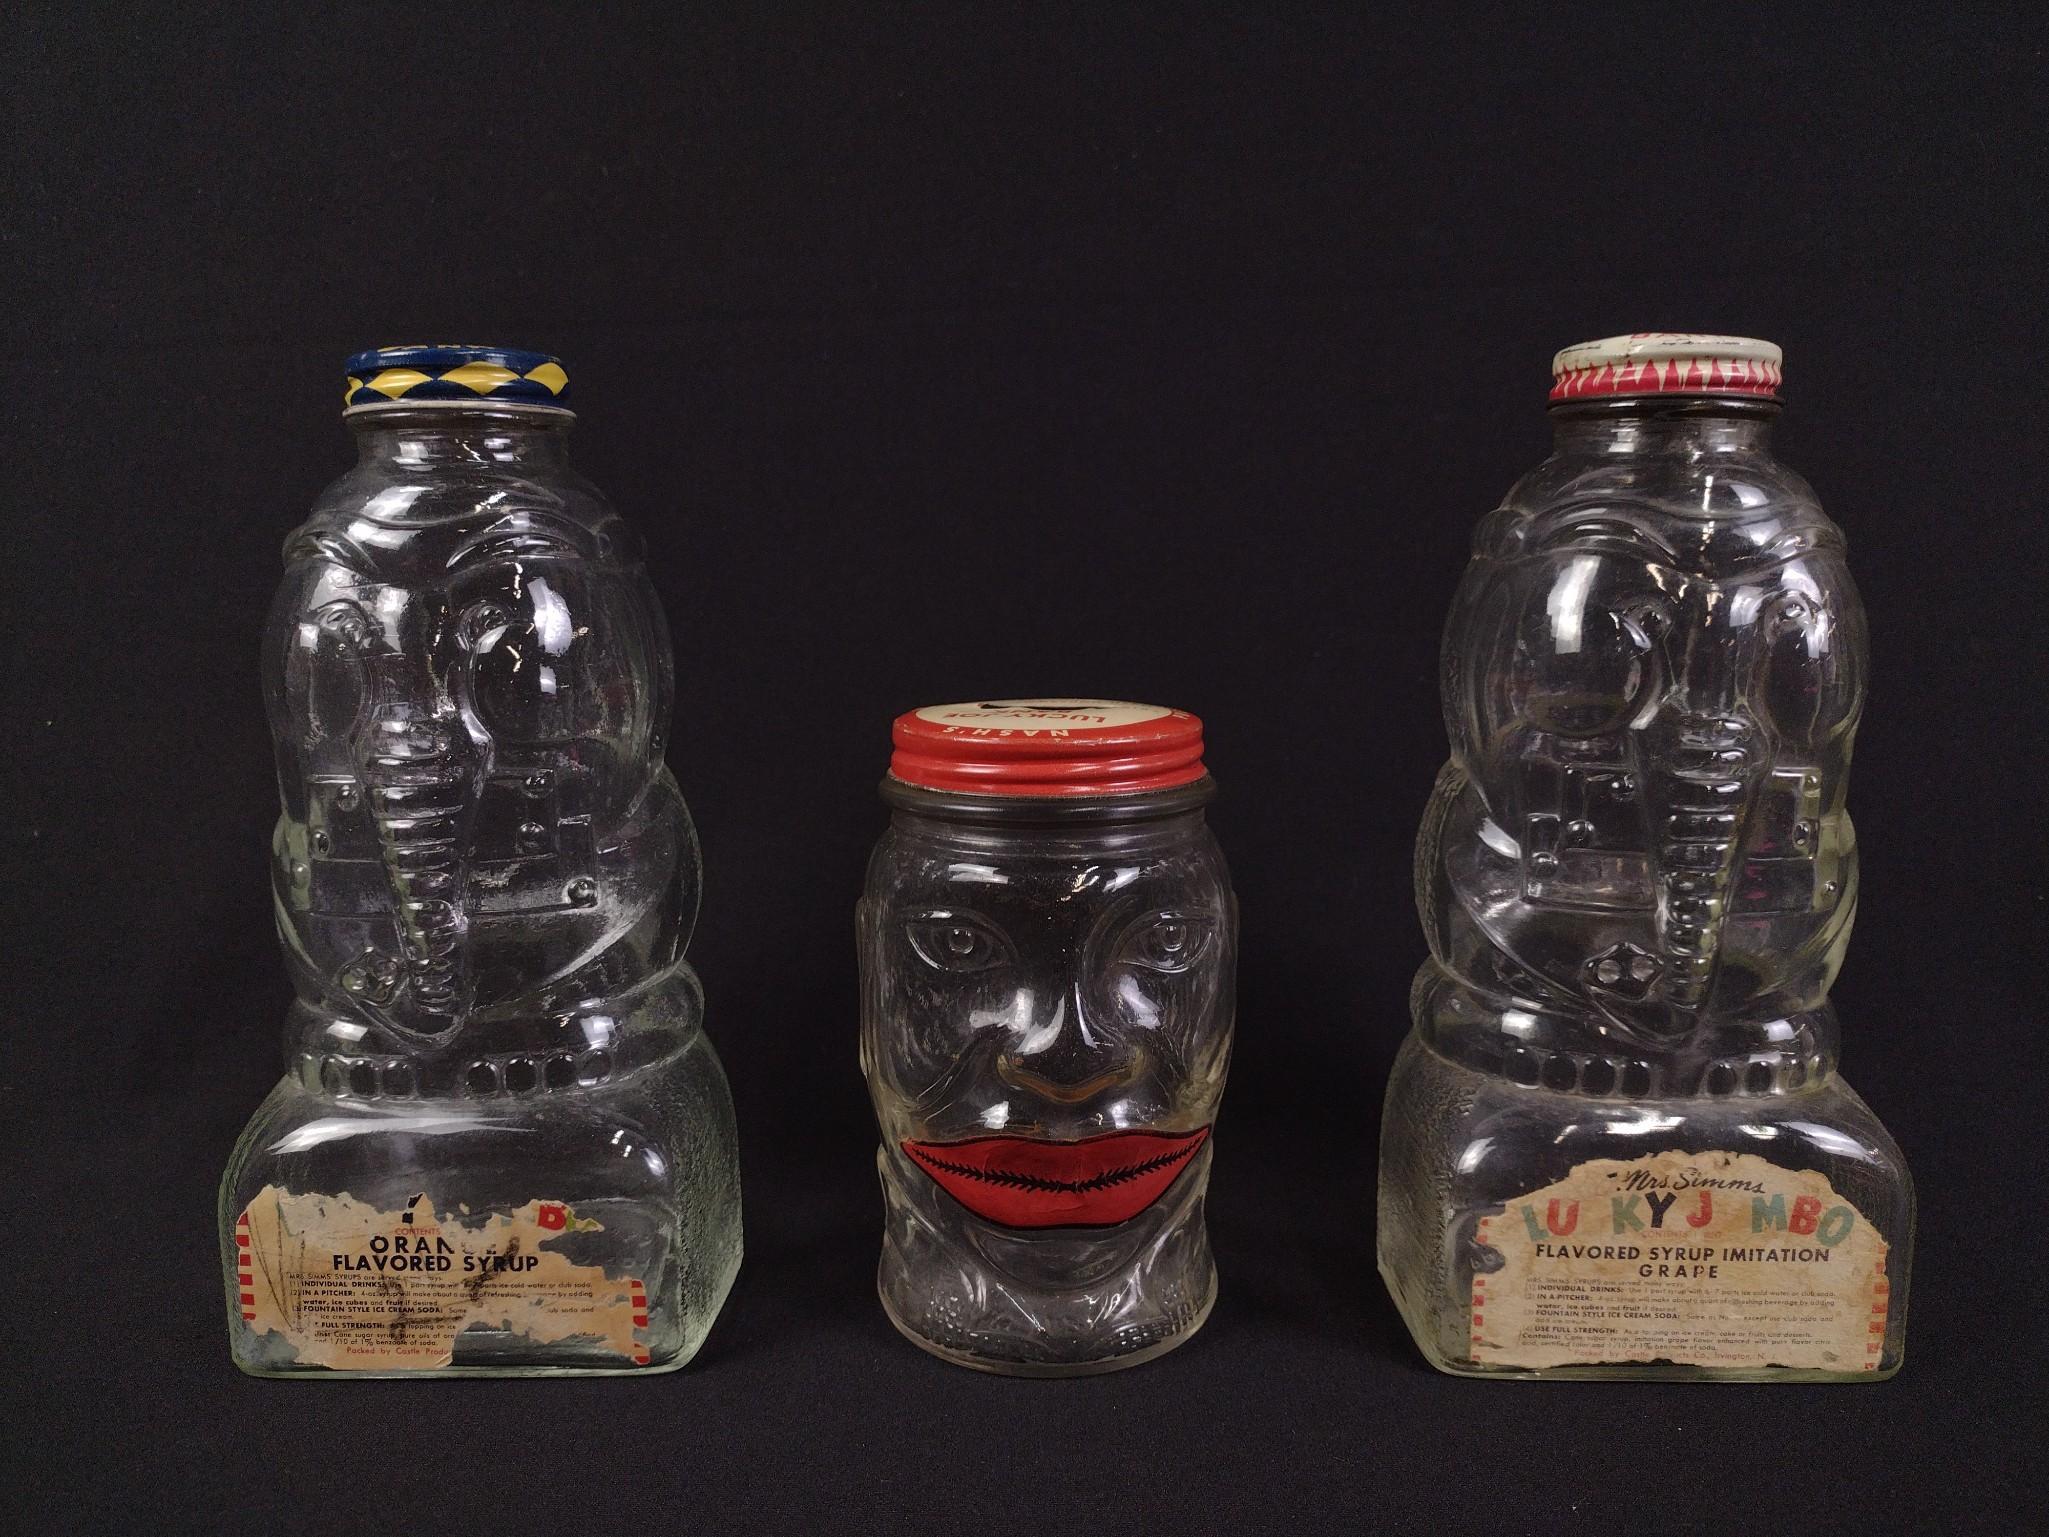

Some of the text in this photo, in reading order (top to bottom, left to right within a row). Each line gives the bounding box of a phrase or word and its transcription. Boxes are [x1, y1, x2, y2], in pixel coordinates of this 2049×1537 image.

[942, 726, 1069, 737] NASH'S
[1673, 1168, 1766, 1194] Simms
[394, 1227, 441, 1236] CONTENTS
[1536, 1243, 1830, 1263] FLAVORED SYRUP IMITATION
[333, 1254, 539, 1272] FLAVORED SYRUP
[1638, 1263, 1718, 1279] GRAPE
[301, 1280, 348, 1288] INDIVIDUAL
[1537, 1284, 1586, 1292] INDIVIDUAL
[302, 1289, 311, 1297] IN
[313, 1289, 320, 1297] A
[303, 1305, 345, 1313] FOUNTAIN
[347, 1305, 370, 1313] STYLE
[373, 1305, 385, 1313] ICE
[1535, 1309, 1580, 1317] FOUNTAIN
[1582, 1310, 1605, 1318] STYLE
[1608, 1311, 1620, 1319] ICE
[1623, 1311, 1651, 1319] CREAM
[321, 1321, 339, 1329] FULL
[395, 1346, 420, 1356] Castle
